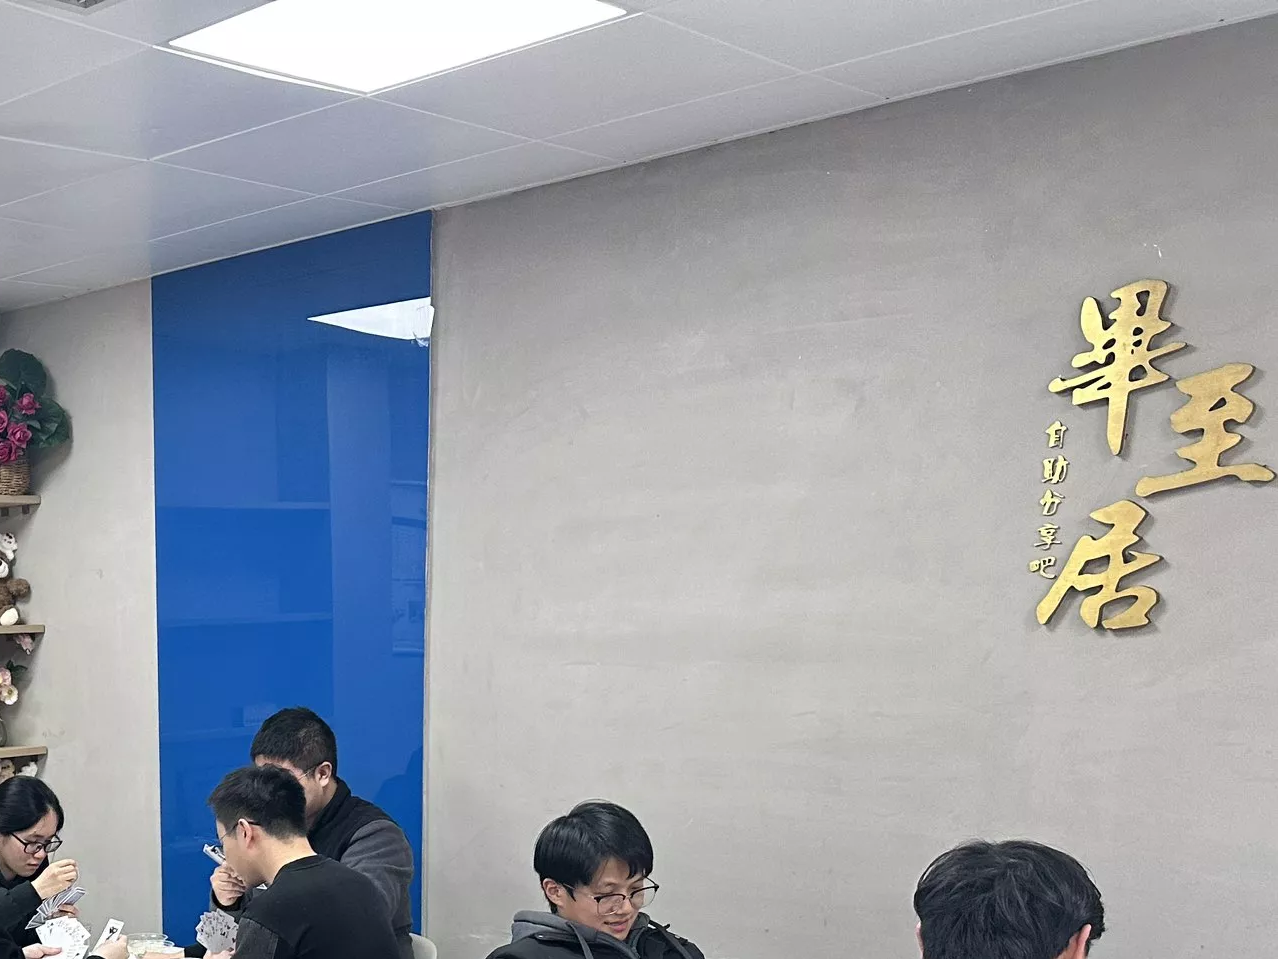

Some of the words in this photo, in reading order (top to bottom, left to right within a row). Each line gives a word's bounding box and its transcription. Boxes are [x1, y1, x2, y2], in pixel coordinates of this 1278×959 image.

[1029, 420, 1069, 579] 自助分享吧
